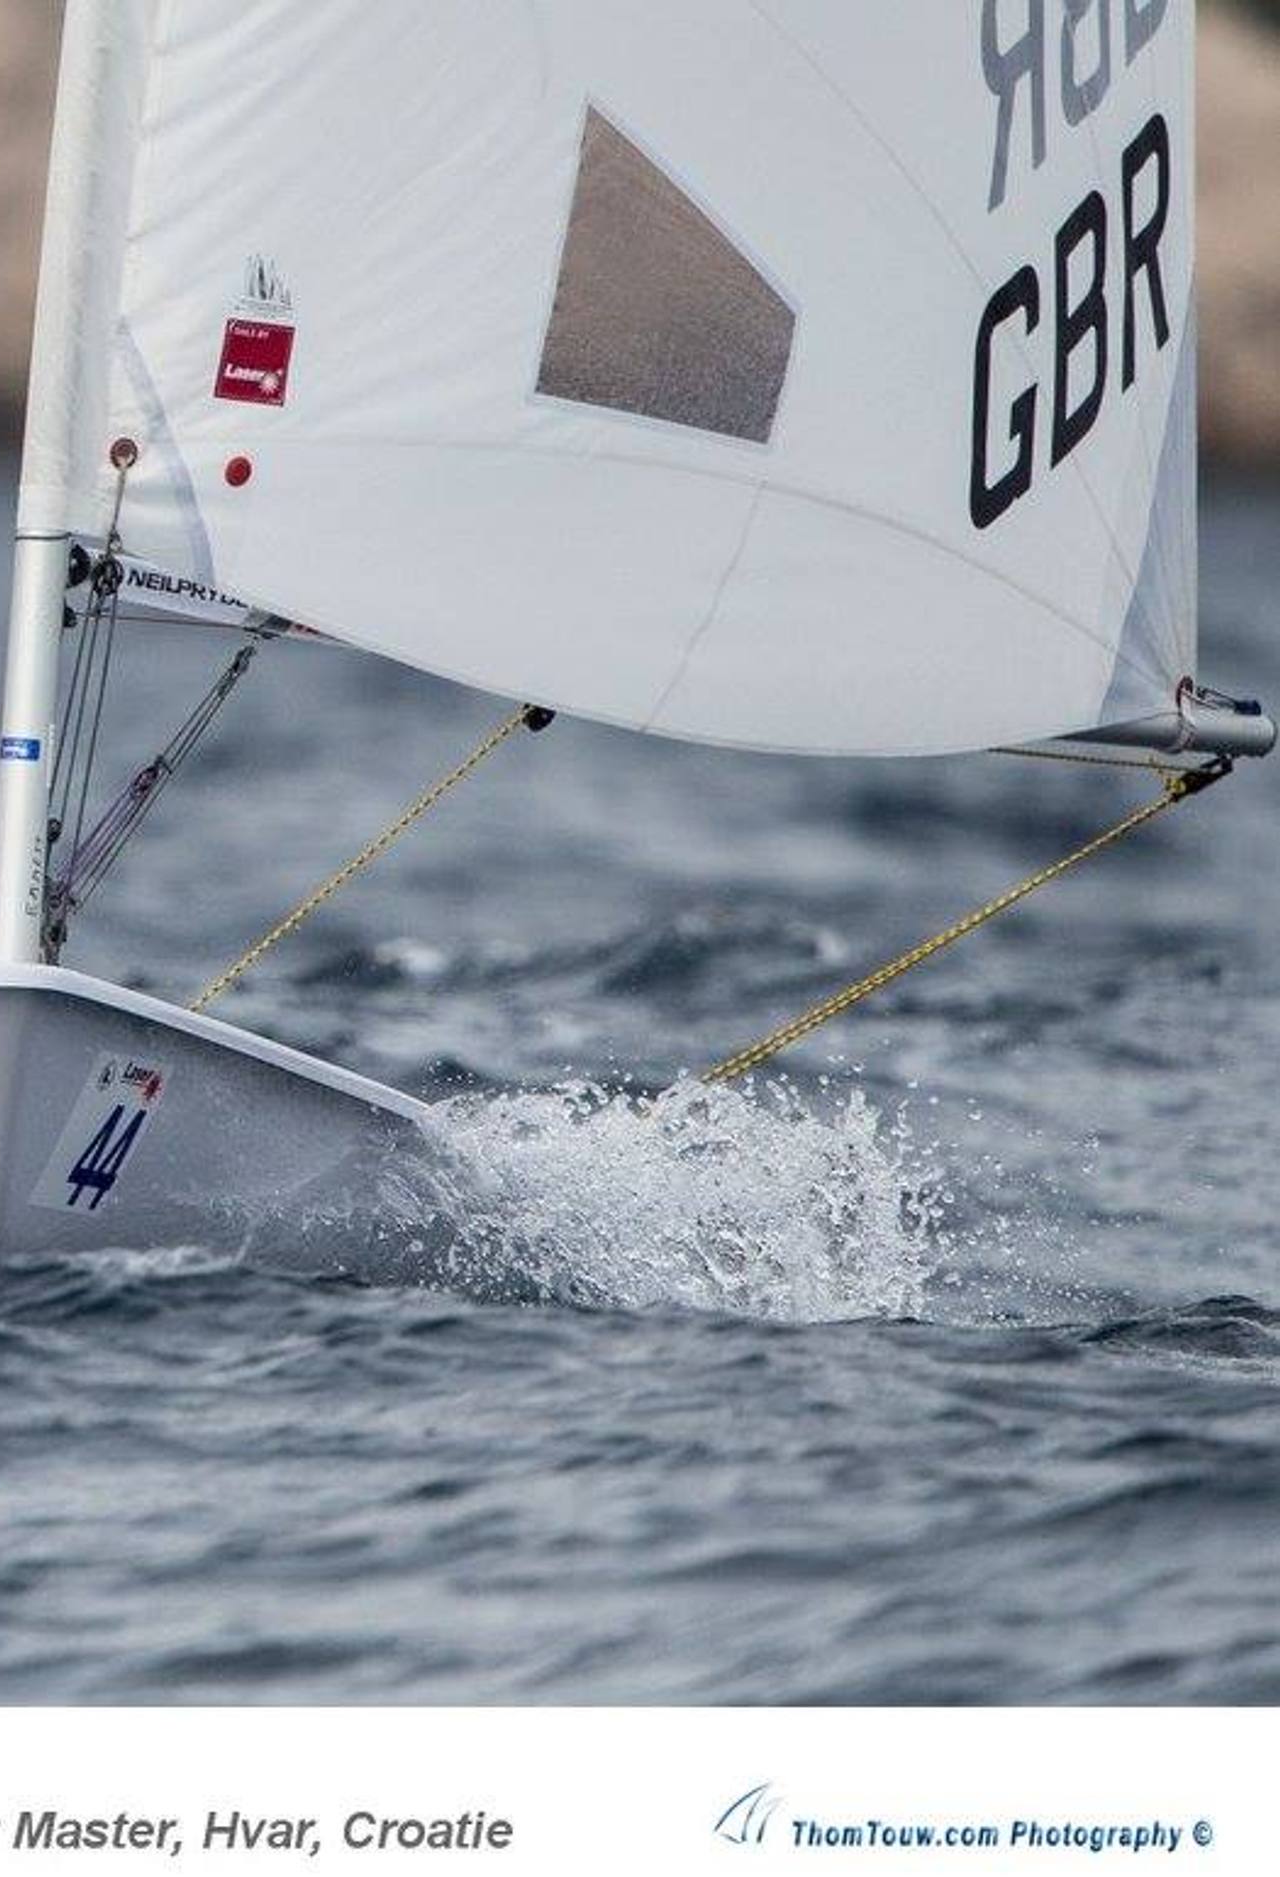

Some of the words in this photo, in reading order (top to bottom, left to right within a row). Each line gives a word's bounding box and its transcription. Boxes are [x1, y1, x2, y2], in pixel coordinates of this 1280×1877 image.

[970, 112, 1170, 530] GBR
[223, 363, 266, 382] Laser
[127, 569, 249, 609] NEILPRY
[66, 1104, 147, 1211] 44
